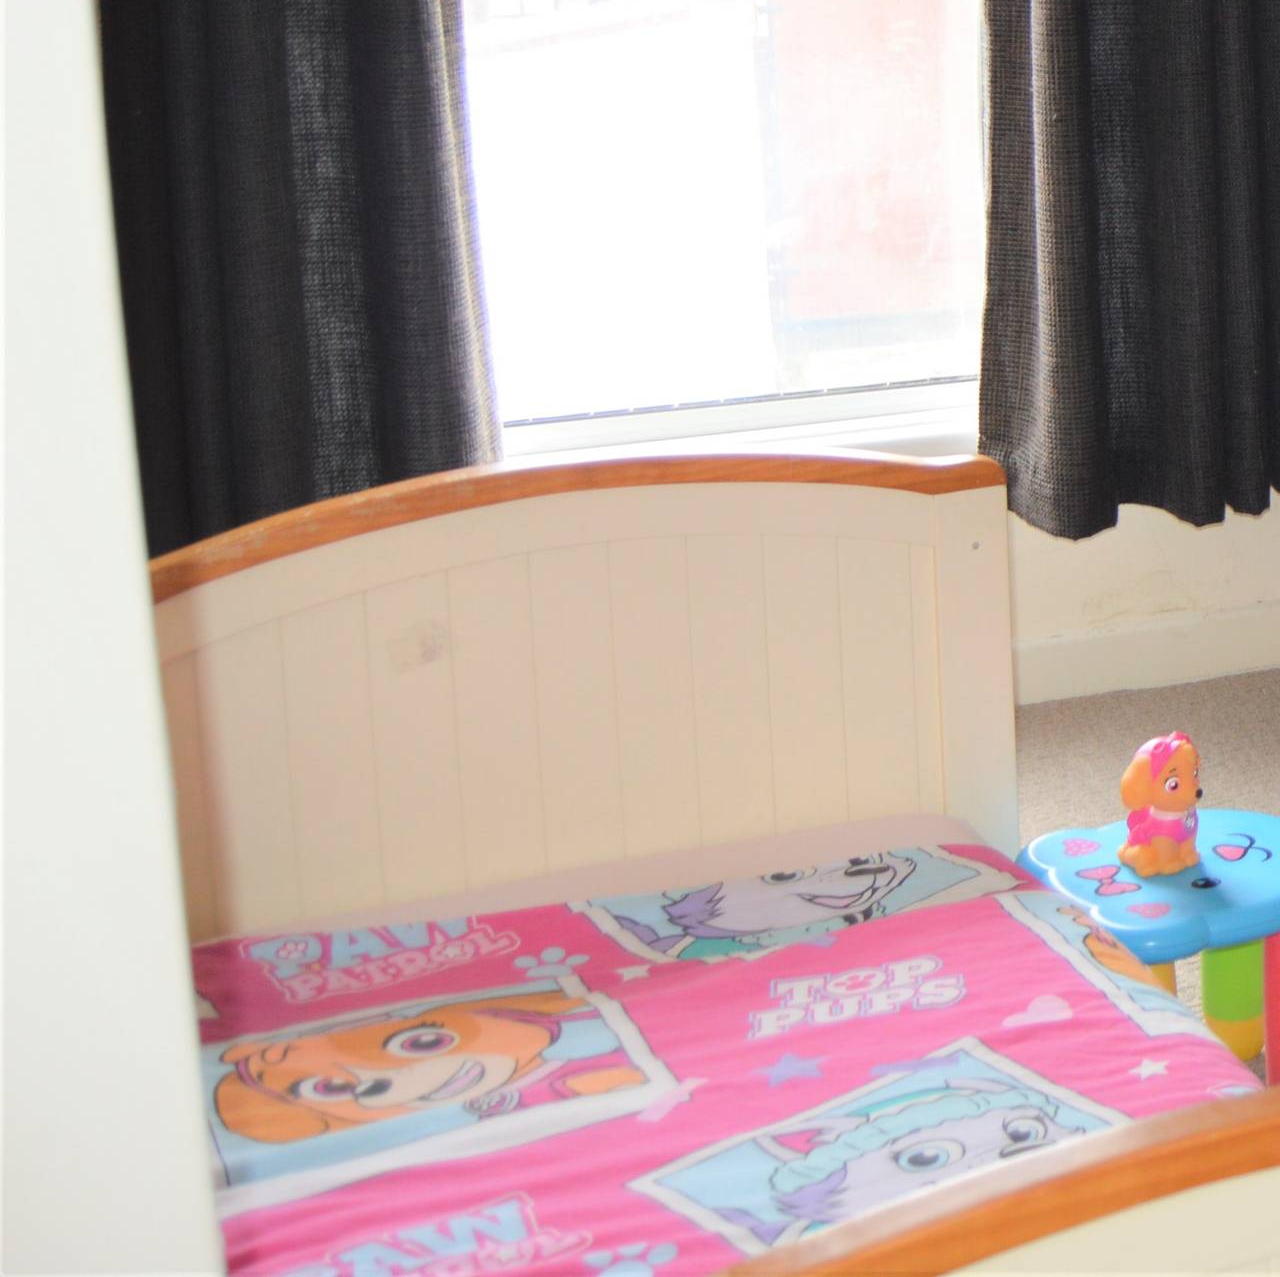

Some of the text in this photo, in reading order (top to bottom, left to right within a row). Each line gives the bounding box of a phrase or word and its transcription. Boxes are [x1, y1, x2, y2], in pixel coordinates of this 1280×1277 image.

[286, 931, 516, 1002] PATROL
[770, 955, 943, 1009] TOP
[747, 974, 966, 1040] PUPS
